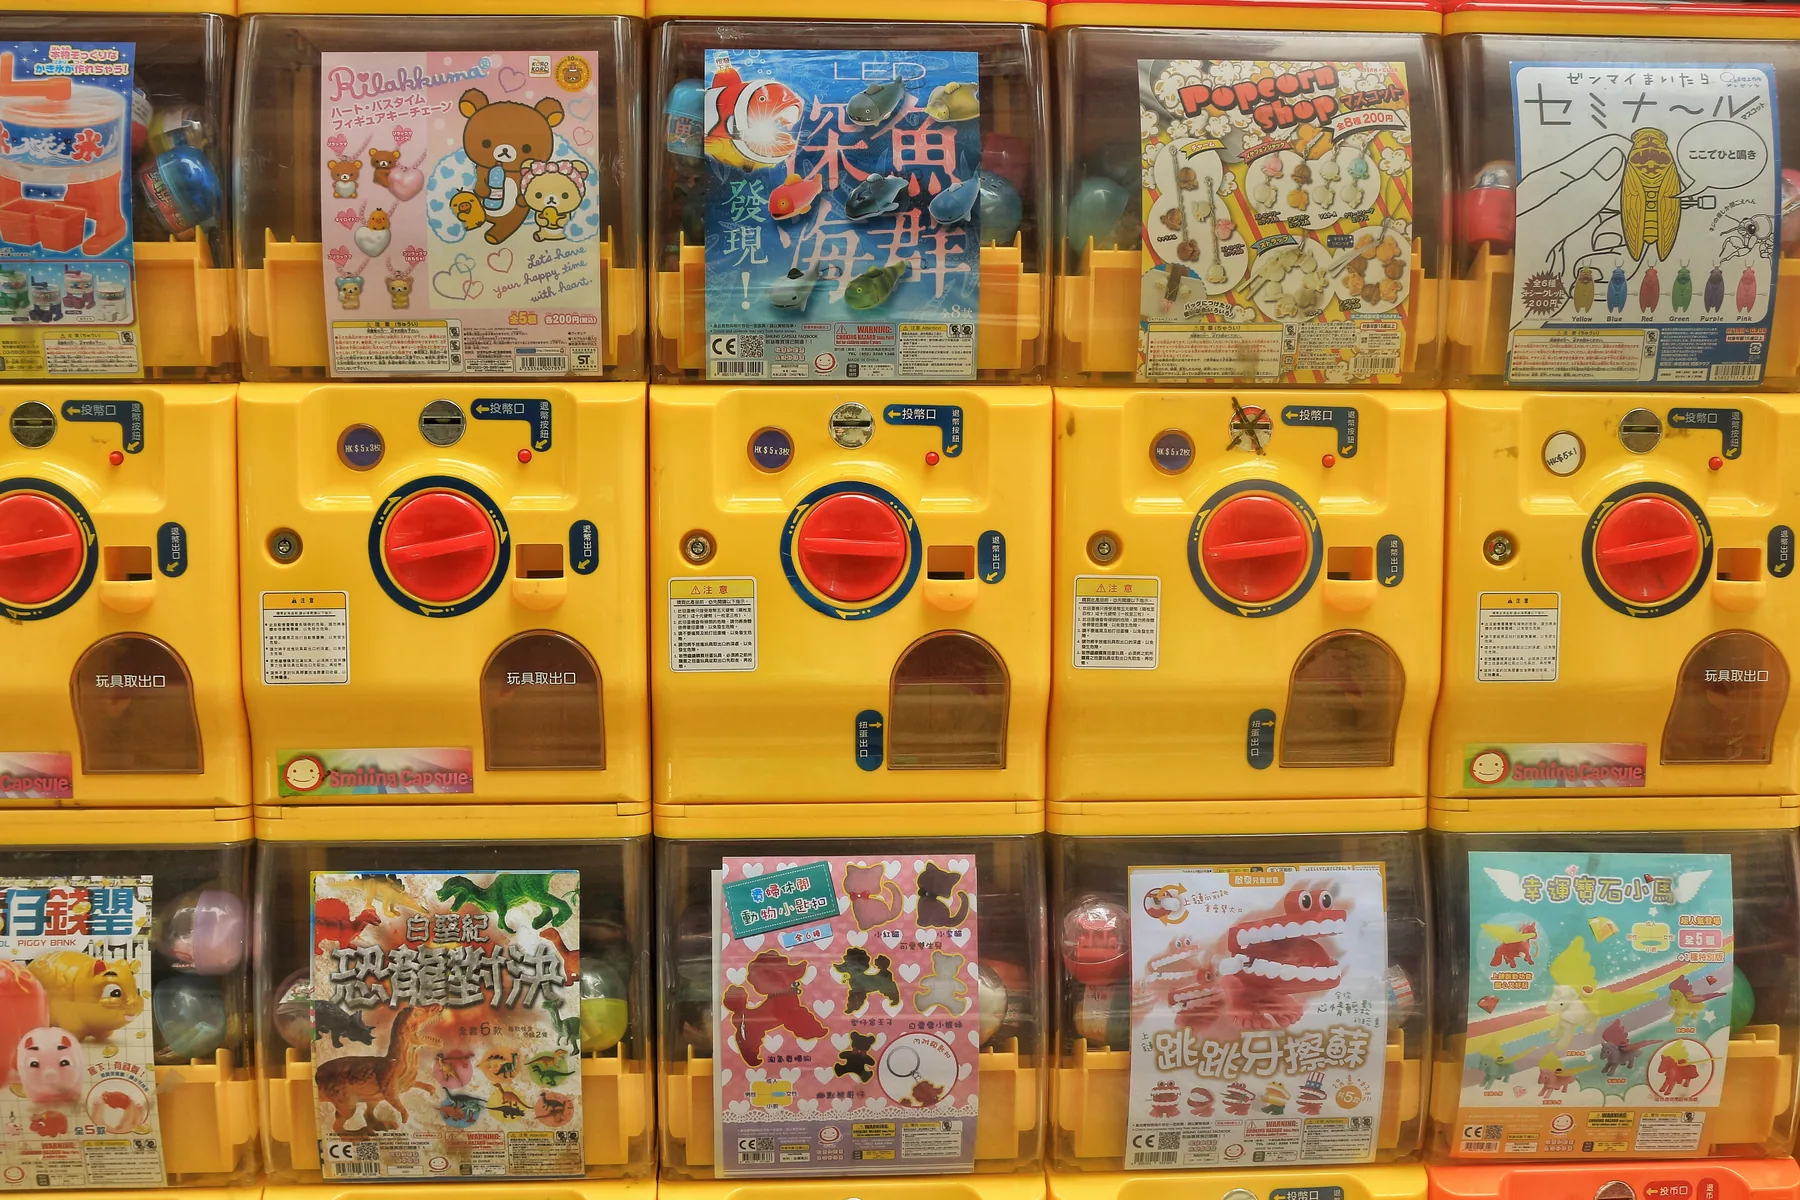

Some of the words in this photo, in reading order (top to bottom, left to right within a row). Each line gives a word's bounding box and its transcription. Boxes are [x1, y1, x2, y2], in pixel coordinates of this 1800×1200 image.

[50, 51, 118, 61] 本物そっくりな
[35, 64, 128, 75] かき氷が作れちゃう!
[833, 61, 927, 81] LED
[1567, 72, 1710, 88] ゼンマイまいたら
[1340, 84, 1404, 110] マスコット
[1363, 112, 1393, 122] 200円
[1741, 102, 1766, 120] マスコット
[1191, 142, 1216, 152] チャーム
[1689, 149, 1756, 160] ここでひと鳴き
[1260, 236, 1288, 248] ストラップ
[554, 247, 586, 260] have
[493, 282, 521, 298] your
[524, 268, 560, 286] happy
[562, 260, 588, 274] time
[530, 286, 556, 302] with
[490, 403, 524, 414] 投幣口
[902, 408, 937, 420] 投幣口
[1299, 409, 1332, 422] 投幣口
[540, 402, 549, 438] 退幣按鈕
[952, 409, 960, 443] 退幣按鈕
[1685, 412, 1718, 424] 投幣口
[1347, 410, 1355, 444] 退幣按鈕
[583, 525, 592, 558] 退幣出口
[992, 536, 1000, 570] 退幣出口
[1390, 540, 1398, 573] 退幣出口
[703, 586, 728, 594] 注意
[1109, 584, 1132, 592] 注意
[96, 674, 166, 687] 玩具取出口
[507, 672, 576, 685] 玩具取出口
[1705, 670, 1768, 682] 玩具取出口
[859, 721, 868, 758] 扭蛋出口
[1251, 720, 1260, 757] 扭蛋出口
[329, 768, 397, 788] Smiling
[400, 770, 468, 787] Capsule
[1512, 762, 1576, 782] Smiling
[1579, 764, 1642, 782] Capsule
[1522, 874, 1676, 905] 幸運寶石小馬
[741, 896, 827, 926] 動物小匙扣
[330, 944, 566, 1009] 恐龍對決
[1156, 1027, 1370, 1080] 跳跳牙擦蘇
[1660, 1186, 1688, 1196] 投币口
